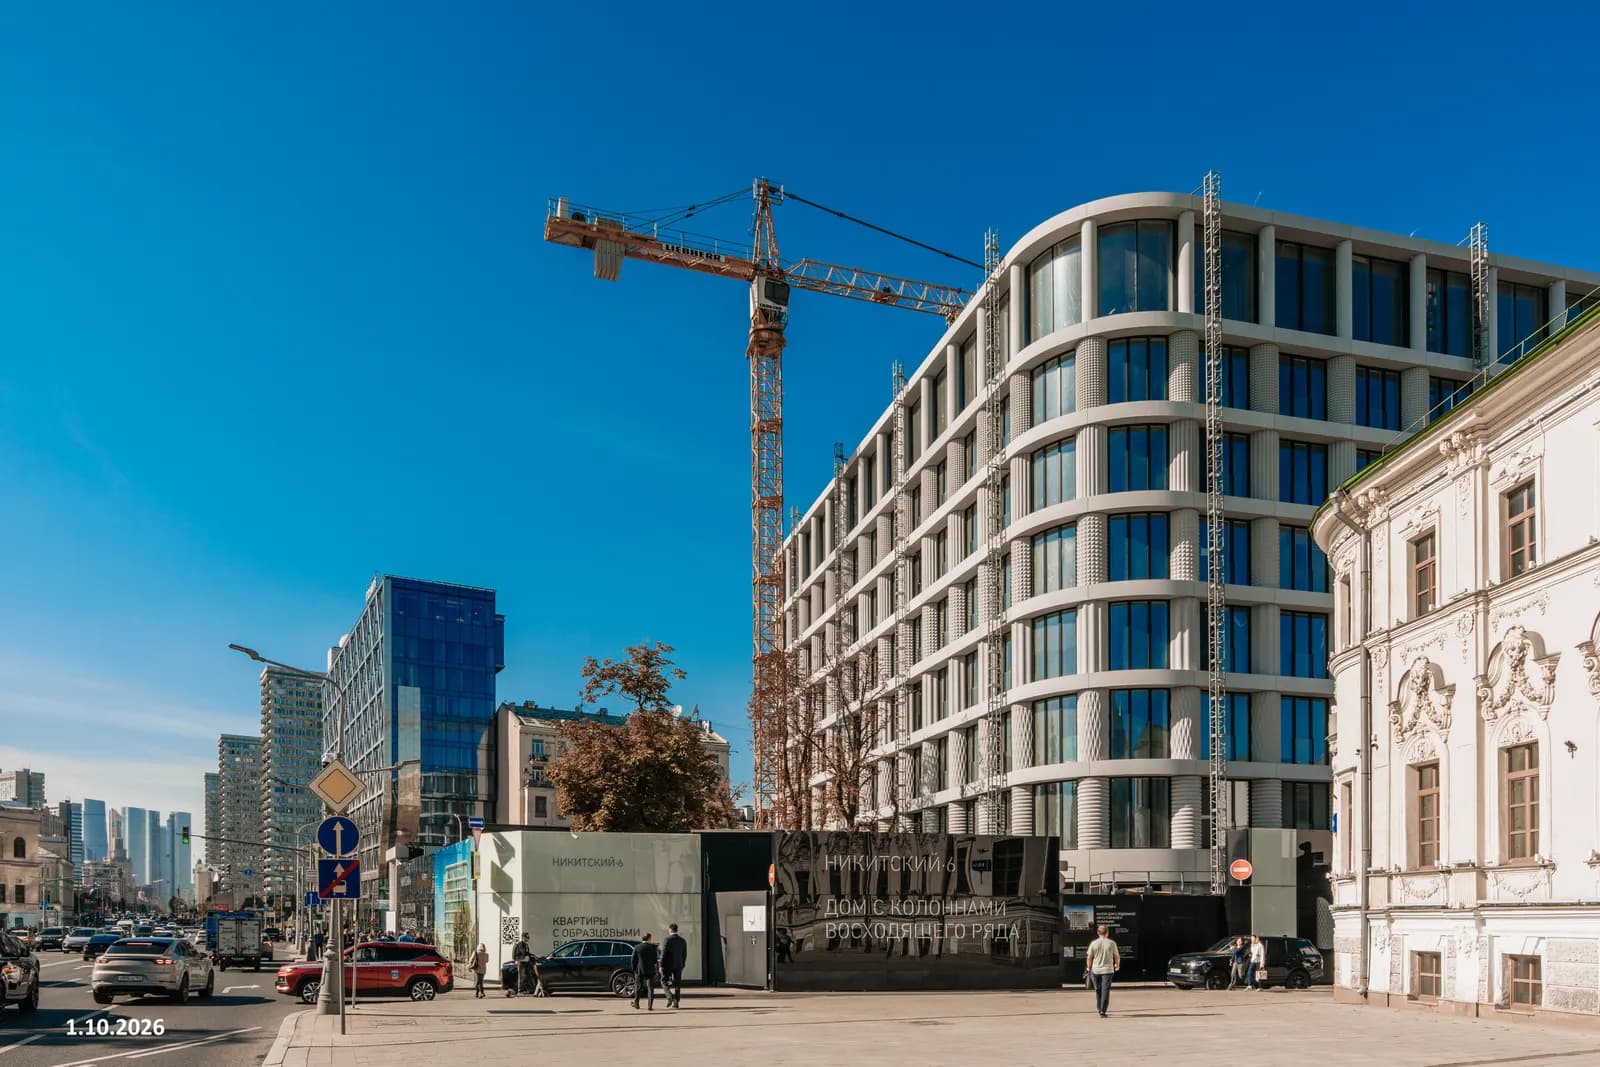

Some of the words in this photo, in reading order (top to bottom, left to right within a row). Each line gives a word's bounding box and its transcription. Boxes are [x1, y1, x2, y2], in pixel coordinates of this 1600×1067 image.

[824, 899, 867, 918] ДОМ
[873, 899, 886, 916] С
[891, 899, 1007, 917] КОЛОННАМИ
[552, 916, 609, 926] КВАРТИРЫ
[552, 928, 560, 938] С
[562, 928, 641, 939] ОБРАЗЦОВЫМИ
[825, 922, 966, 942] ВОСХОДЯЩЕГО
[972, 922, 1020, 943] РЯДА
